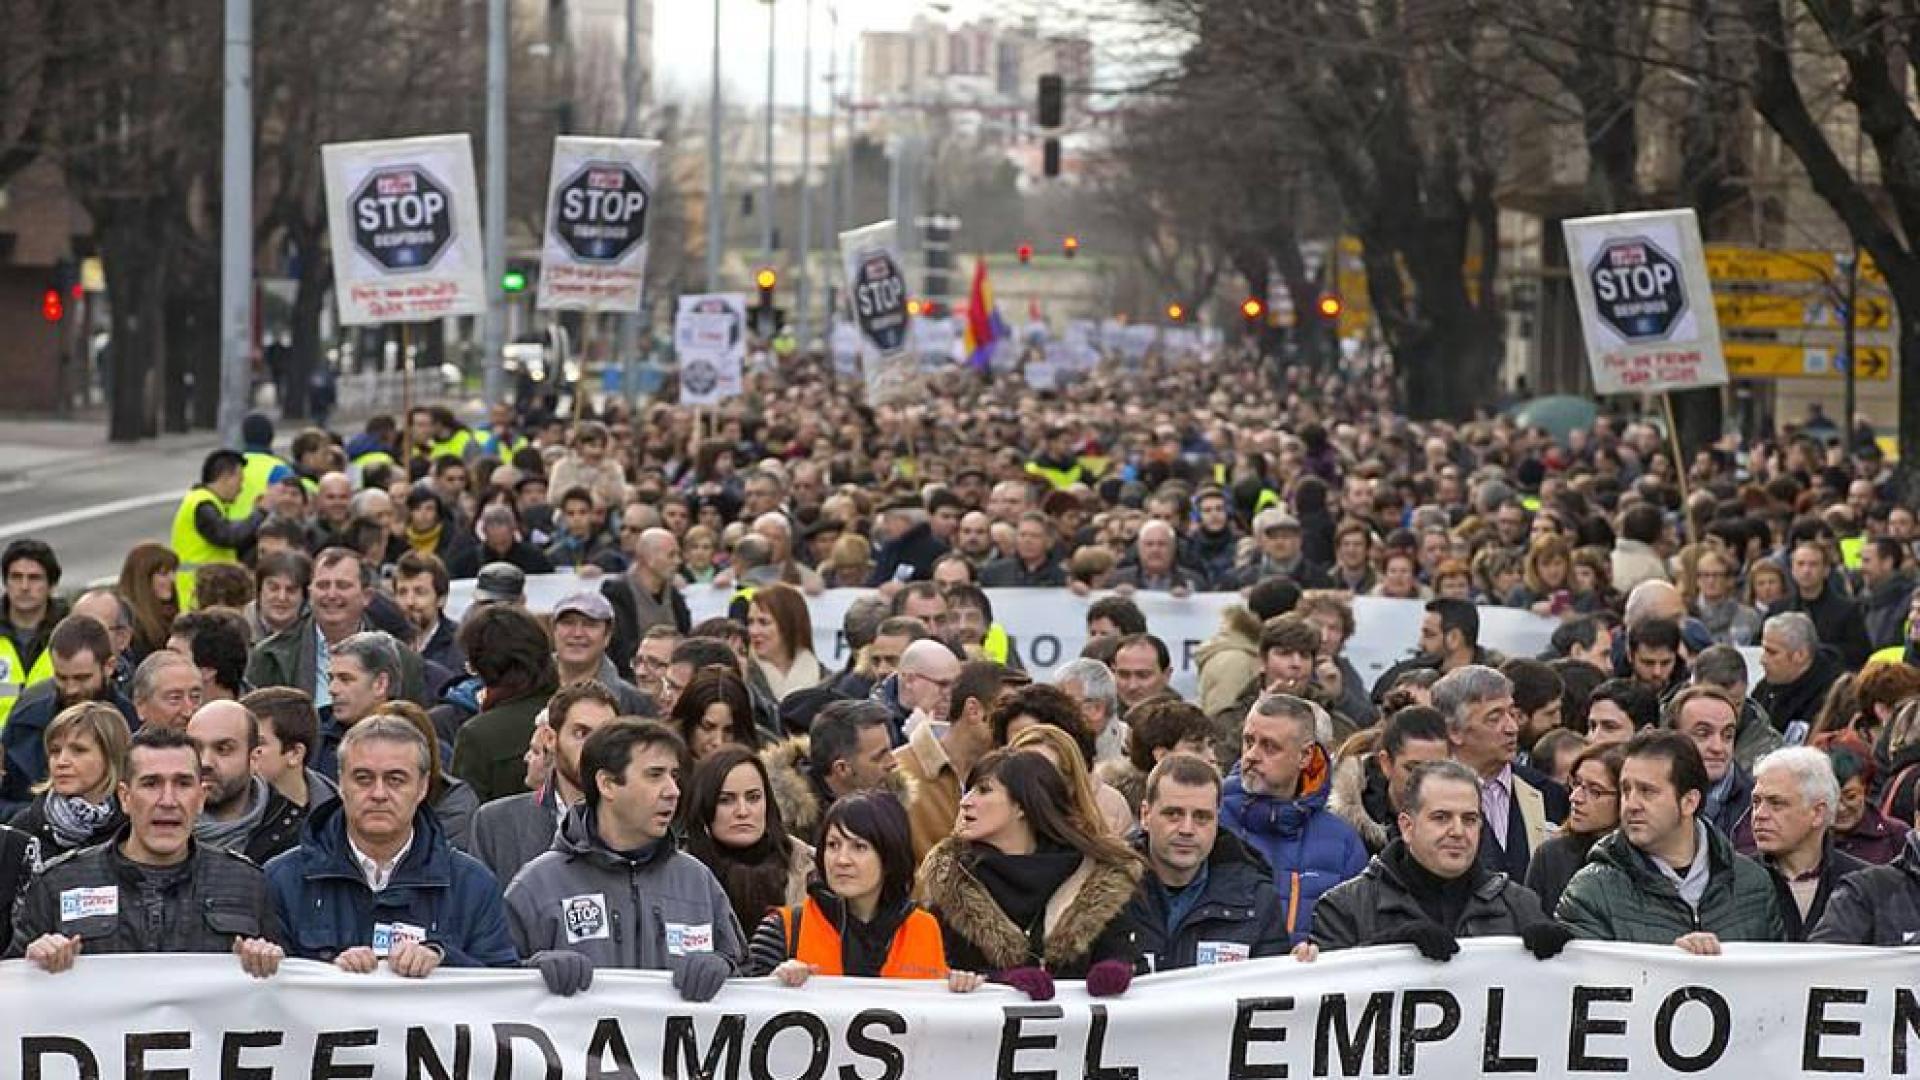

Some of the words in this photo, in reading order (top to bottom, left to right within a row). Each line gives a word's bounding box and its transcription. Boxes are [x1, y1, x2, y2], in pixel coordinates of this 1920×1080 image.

[357, 191, 444, 230] STOP
[562, 187, 645, 222] STOP
[858, 276, 902, 316] STOP
[1597, 263, 1673, 301] STOP
[567, 906, 600, 924] STOP
[997, 1004, 1138, 1080] EL
[1228, 986, 1732, 1080] EMPLEO
